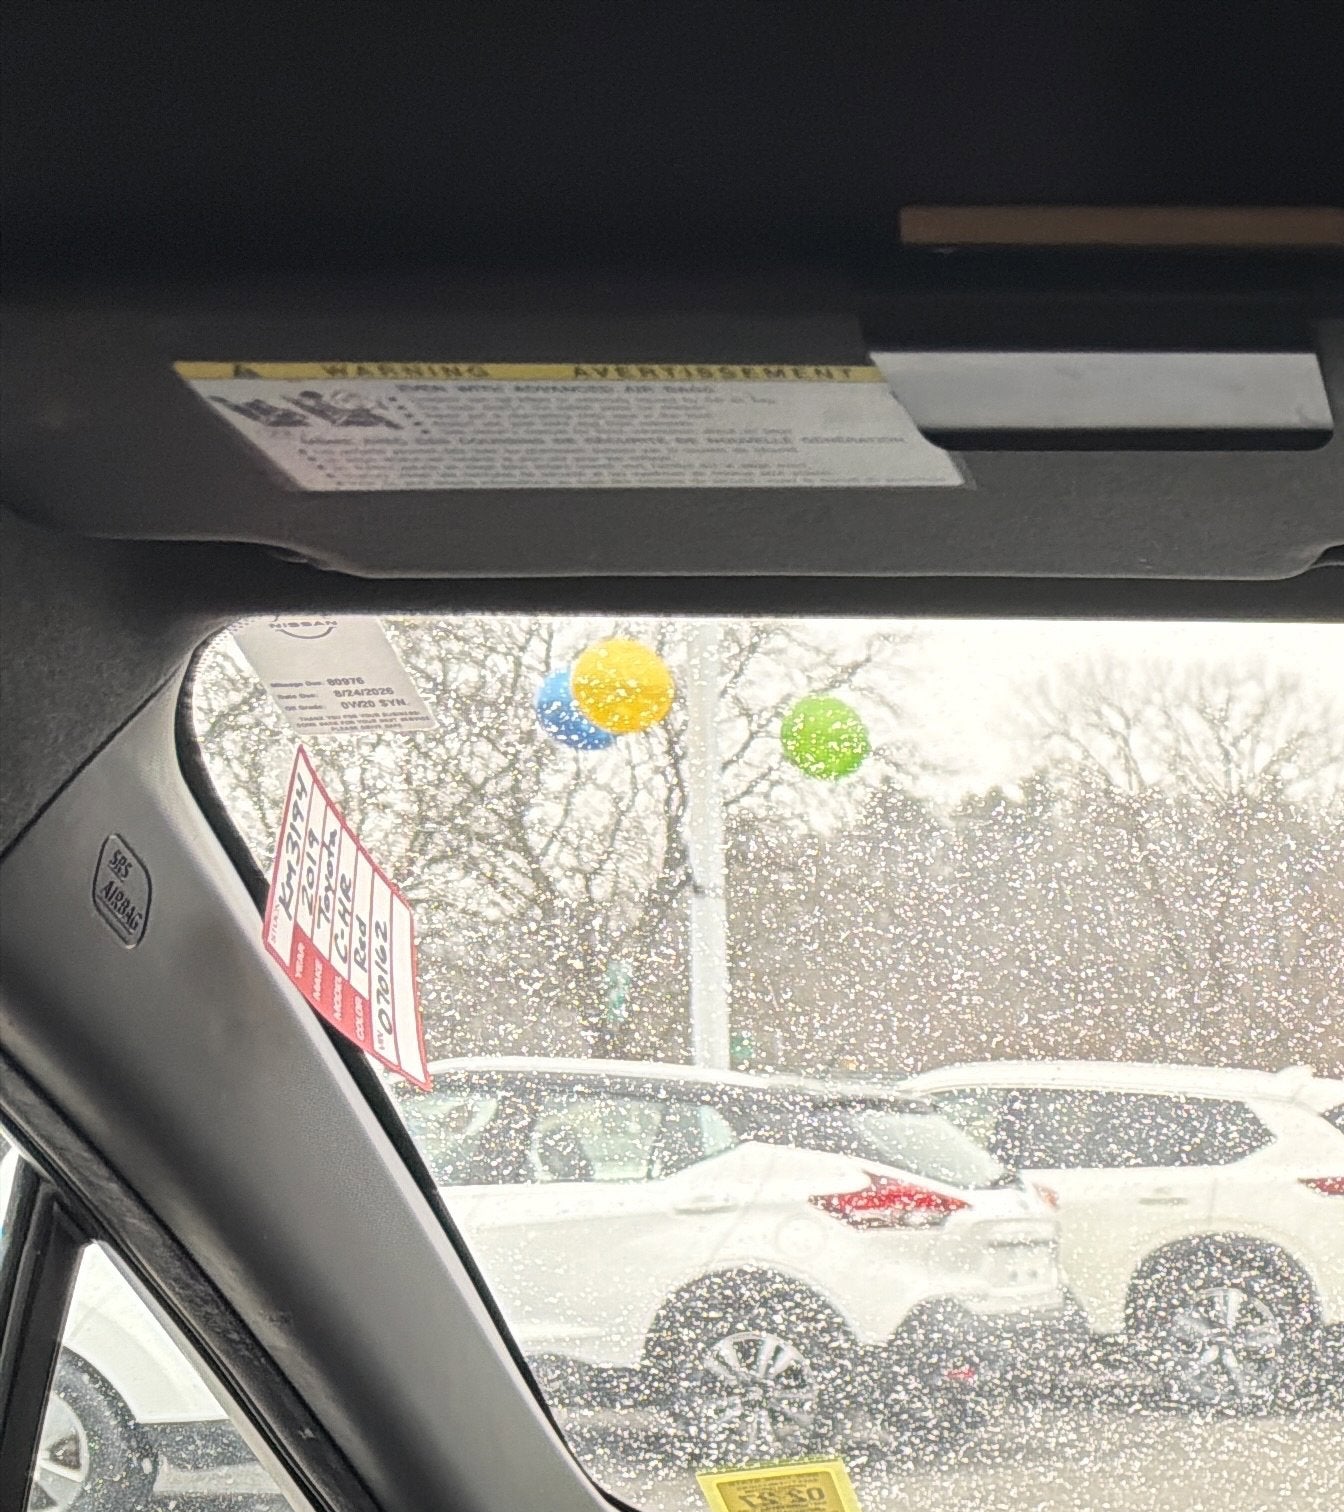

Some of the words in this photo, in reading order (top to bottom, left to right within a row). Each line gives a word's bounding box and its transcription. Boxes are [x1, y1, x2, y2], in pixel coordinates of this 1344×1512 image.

[321, 365, 489, 377] WARNING
[574, 365, 851, 379] AVERTISSEMENT
[269, 621, 338, 629] NISSAN
[109, 850, 133, 879] SRS
[302, 828, 319, 915] 2019
[317, 829, 338, 929] Toyota
[100, 880, 143, 931] AIRBAG
[334, 873, 352, 964] C-HR
[313, 959, 324, 1001] MAKE
[332, 975, 343, 1021] MODEL
[354, 996, 365, 1040] COLOR
